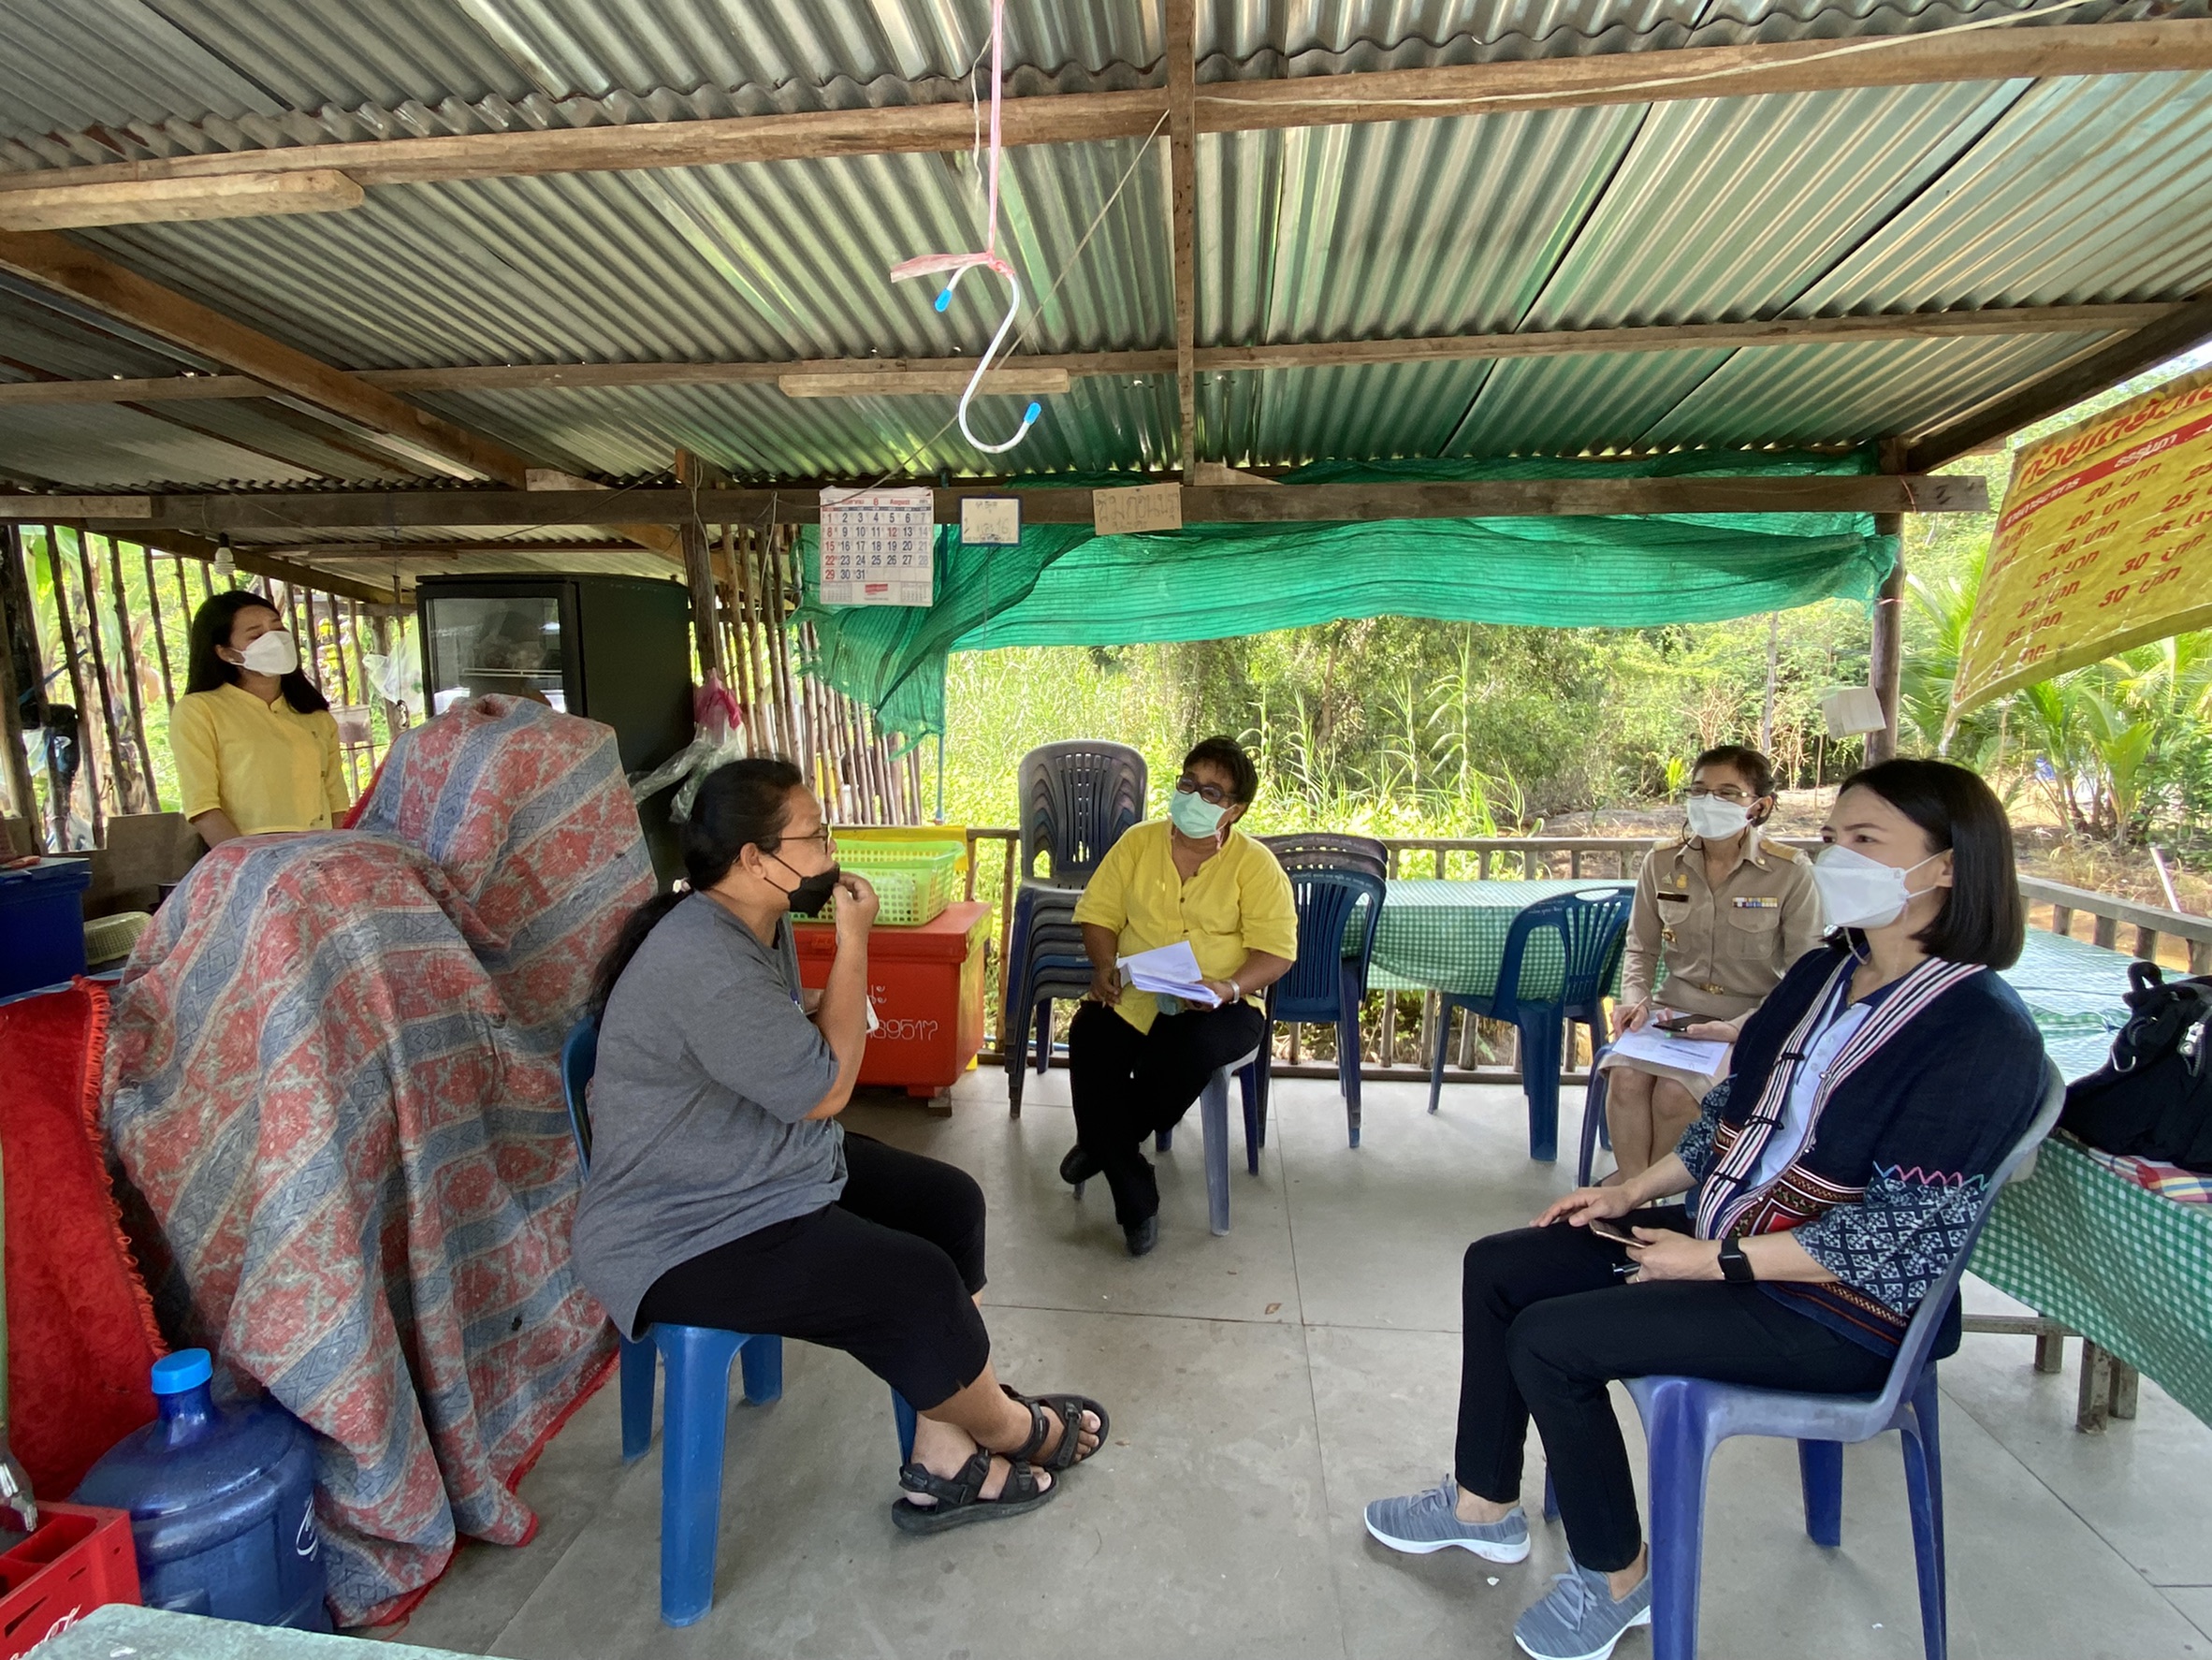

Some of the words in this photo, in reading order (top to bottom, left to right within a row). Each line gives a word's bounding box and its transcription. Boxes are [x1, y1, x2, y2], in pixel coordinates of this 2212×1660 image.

[2083, 483, 2111, 504] 20
[2120, 462, 2162, 487] บาท
[873, 497, 880, 506] 8
[2065, 510, 2094, 531] 20
[2101, 491, 2141, 516] บาท
[827, 513, 832, 523] 1
[842, 513, 848, 523] 2
[858, 513, 864, 523] 3
[873, 513, 879, 523] 4
[889, 513, 895, 523] 5
[905, 513, 910, 523] 6
[921, 513, 925, 523] 7
[2048, 538, 2077, 561] 20
[2083, 520, 2120, 545] บาท
[2161, 488, 2199, 513] 25
[827, 527, 833, 536] 8
[842, 527, 848, 536] 9
[856, 527, 866, 536] 10
[871, 527, 880, 536] 11
[888, 527, 897, 536] 12
[903, 527, 912, 536] 13
[919, 527, 928, 536] 14
[825, 541, 835, 551] 15
[841, 541, 851, 551] 16
[856, 541, 866, 551] 17
[872, 541, 881, 551] 18
[888, 541, 897, 551] 19
[902, 541, 912, 551] 20
[918, 541, 927, 551] 21
[2032, 566, 2058, 590] 20
[2062, 550, 2100, 575] บาท
[2138, 519, 2176, 544] 25
[825, 555, 835, 565] 22
[840, 555, 851, 565] 23
[856, 555, 866, 565] 24
[871, 555, 881, 565] 25
[887, 555, 896, 565] 26
[902, 555, 912, 565] 27
[918, 555, 928, 565] 28
[825, 570, 835, 579] 29
[840, 570, 851, 579] 30
[856, 570, 866, 579] 31
[2017, 596, 2041, 619] 25
[2118, 552, 2150, 575] 30
[2098, 585, 2131, 608] 30
[2138, 566, 2182, 593] บาท
